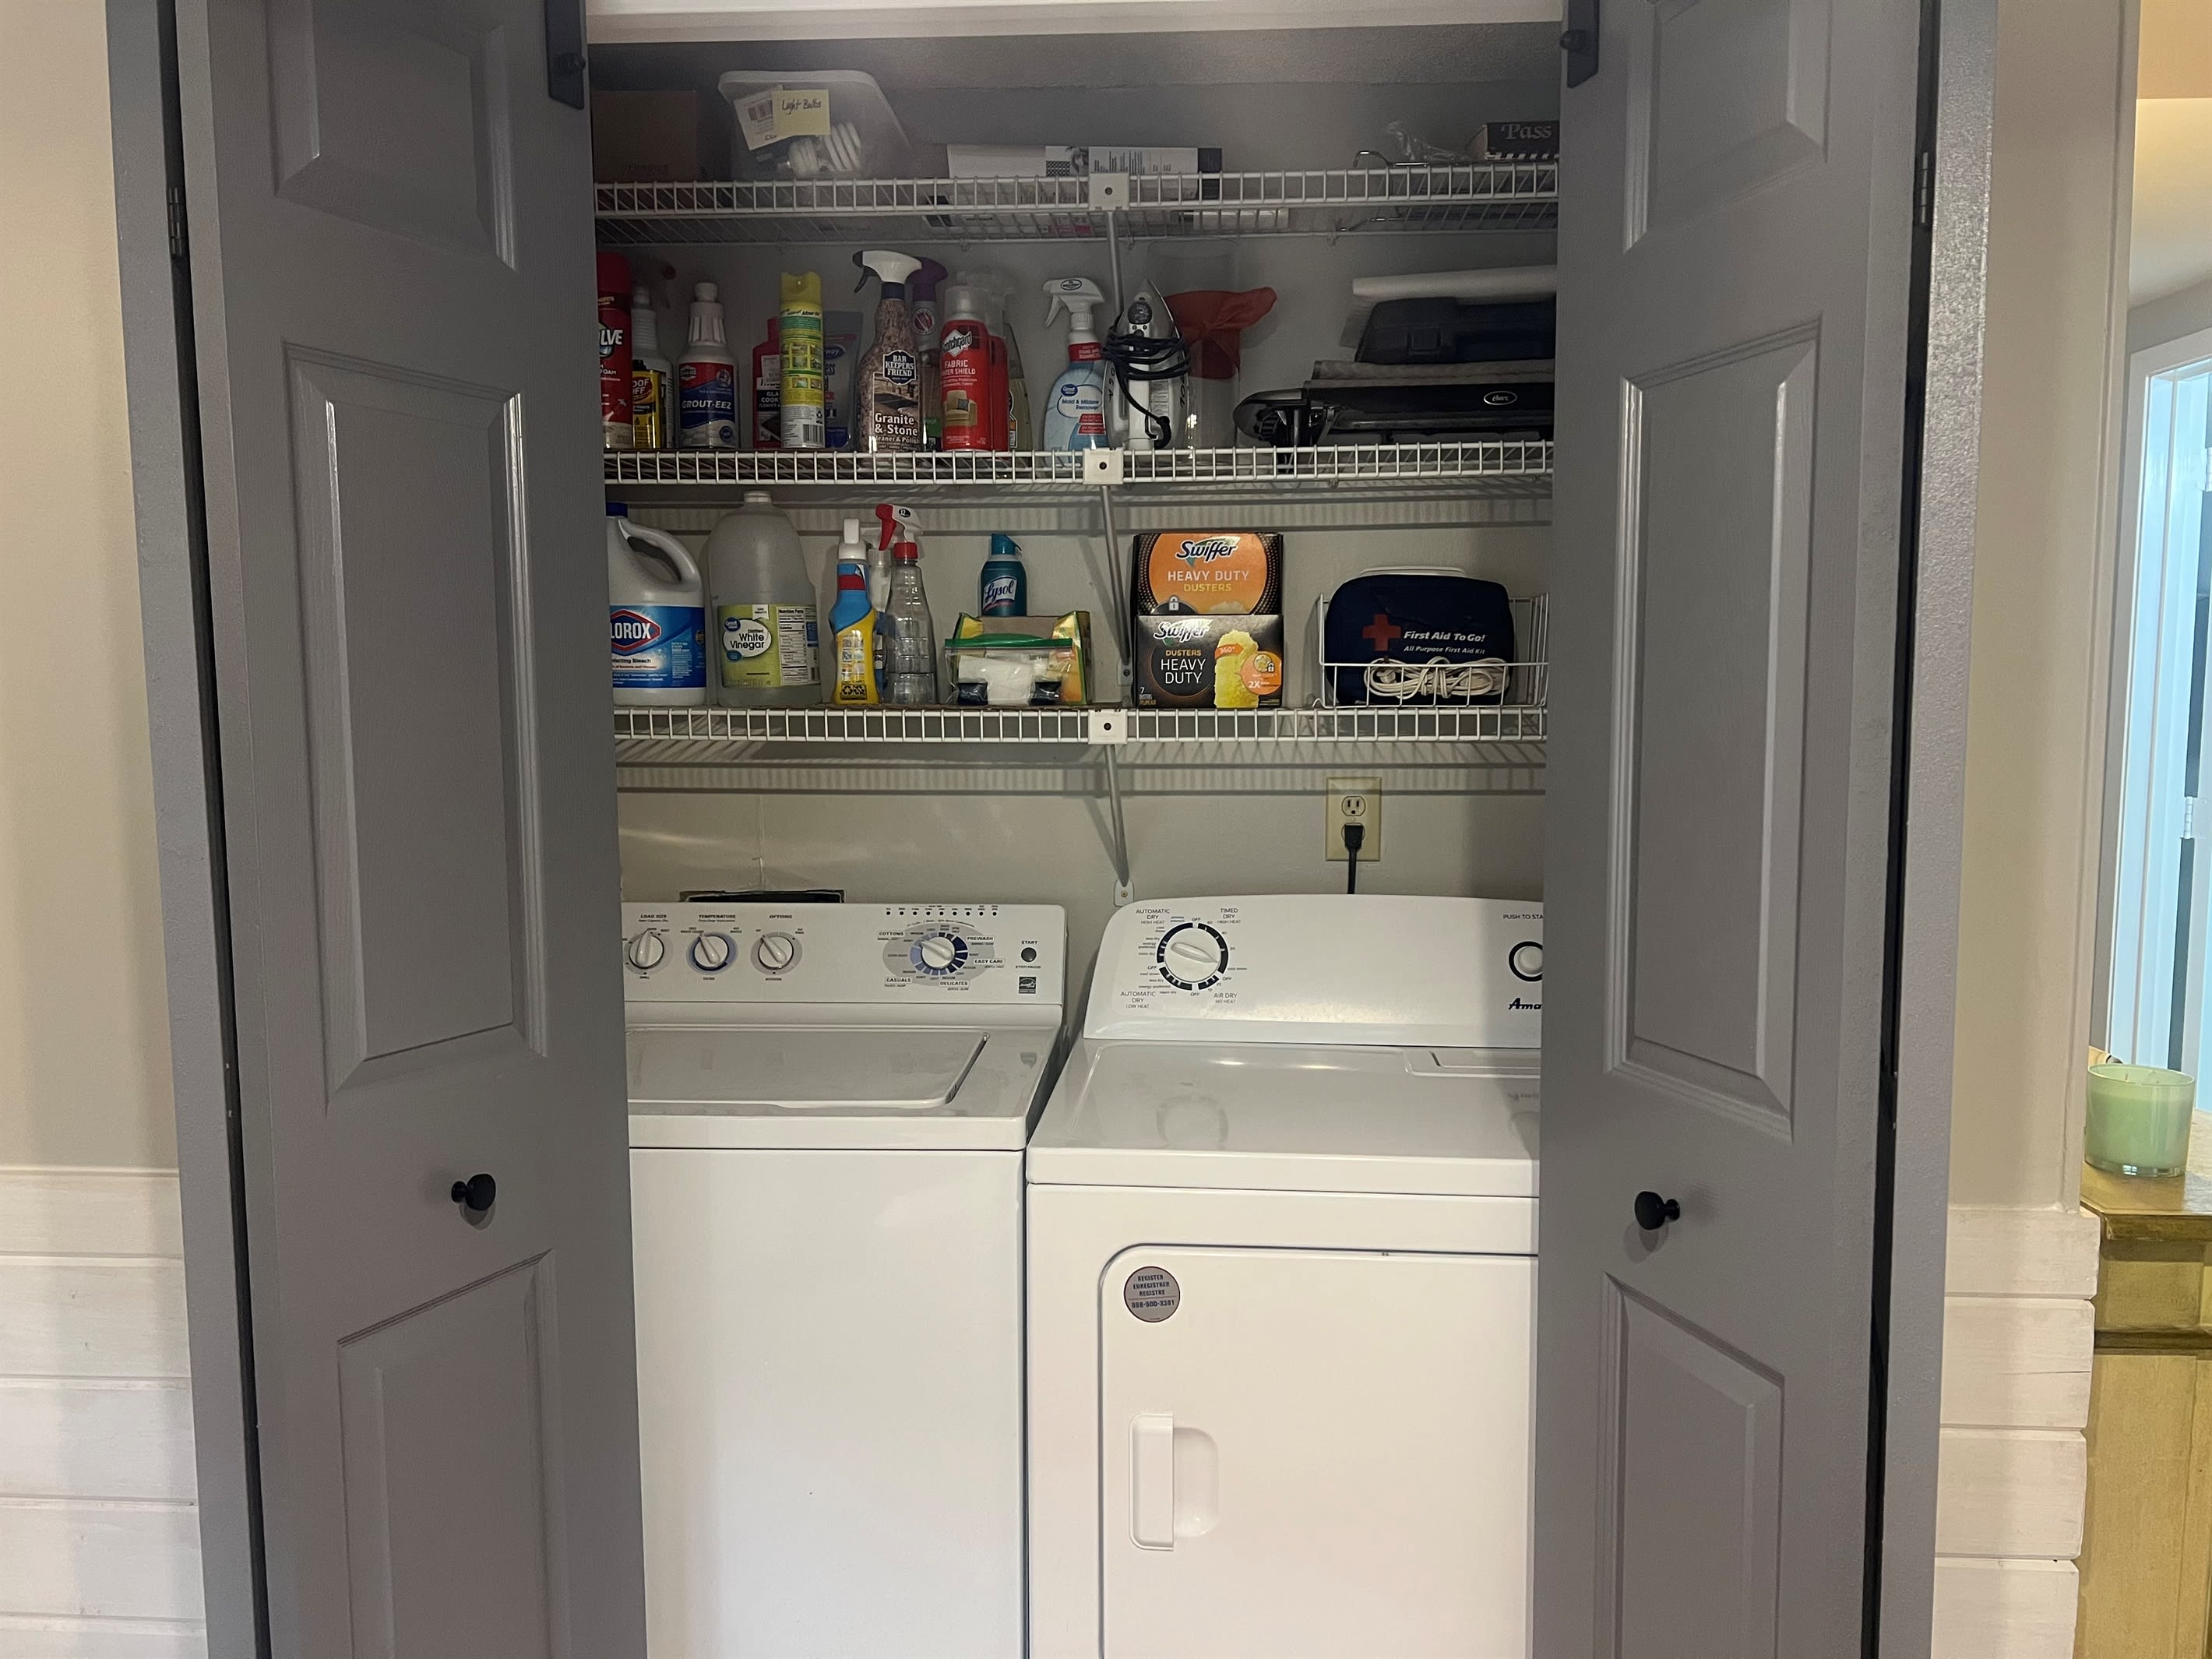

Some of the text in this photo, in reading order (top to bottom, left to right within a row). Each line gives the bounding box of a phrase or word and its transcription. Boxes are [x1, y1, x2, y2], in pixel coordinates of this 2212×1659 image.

[781, 98, 822, 114] Light Bulbs
[1501, 124, 1552, 139] Pass
[885, 361, 914, 370] KEEPERS
[945, 360, 968, 368] FABRIC
[887, 368, 912, 377] FRIEND
[875, 413, 914, 425] Granite
[875, 424, 918, 436] & Stone
[1176, 541, 1237, 562] Swiffer
[1168, 570, 1249, 581] HEAVY DUTY
[984, 579, 1015, 603] Lysol
[1184, 583, 1231, 592] DUSTERS
[610, 623, 651, 639] LOROX
[1154, 622, 1208, 643] Swiffer
[1404, 631, 1429, 639] First
[1431, 632, 1451, 640] Aid
[1467, 634, 1485, 643] Go!
[730, 641, 764, 650] Vinegar
[1161, 659, 1206, 671] HEAVY
[1165, 672, 1203, 684] DUTY
[1509, 998, 1542, 1010] Ama
